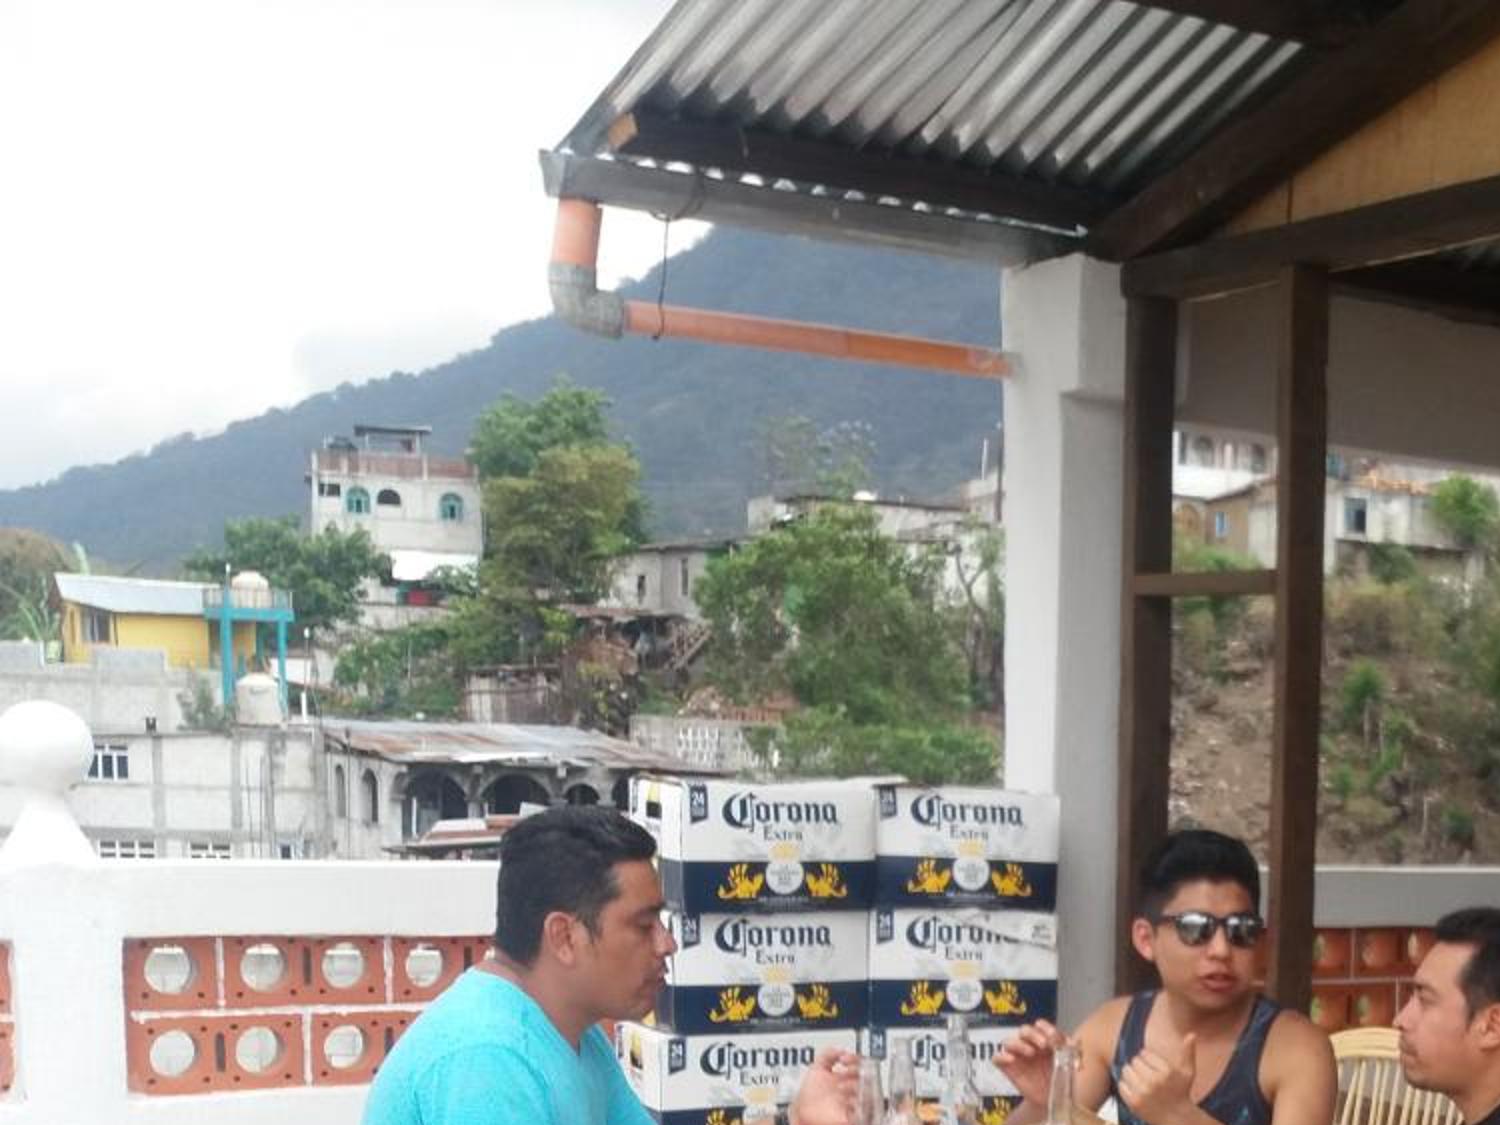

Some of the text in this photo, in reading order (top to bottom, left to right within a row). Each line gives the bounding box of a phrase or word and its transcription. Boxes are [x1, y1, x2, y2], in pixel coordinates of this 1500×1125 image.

[722, 792, 838, 832] Corona
[911, 795, 1024, 831] Corona
[763, 826, 803, 841] Extra
[950, 825, 989, 840] Extra
[715, 919, 832, 956] Corona
[755, 951, 795, 964] Extra
[945, 947, 983, 961] Extra
[740, 1072, 779, 1086] Extra
